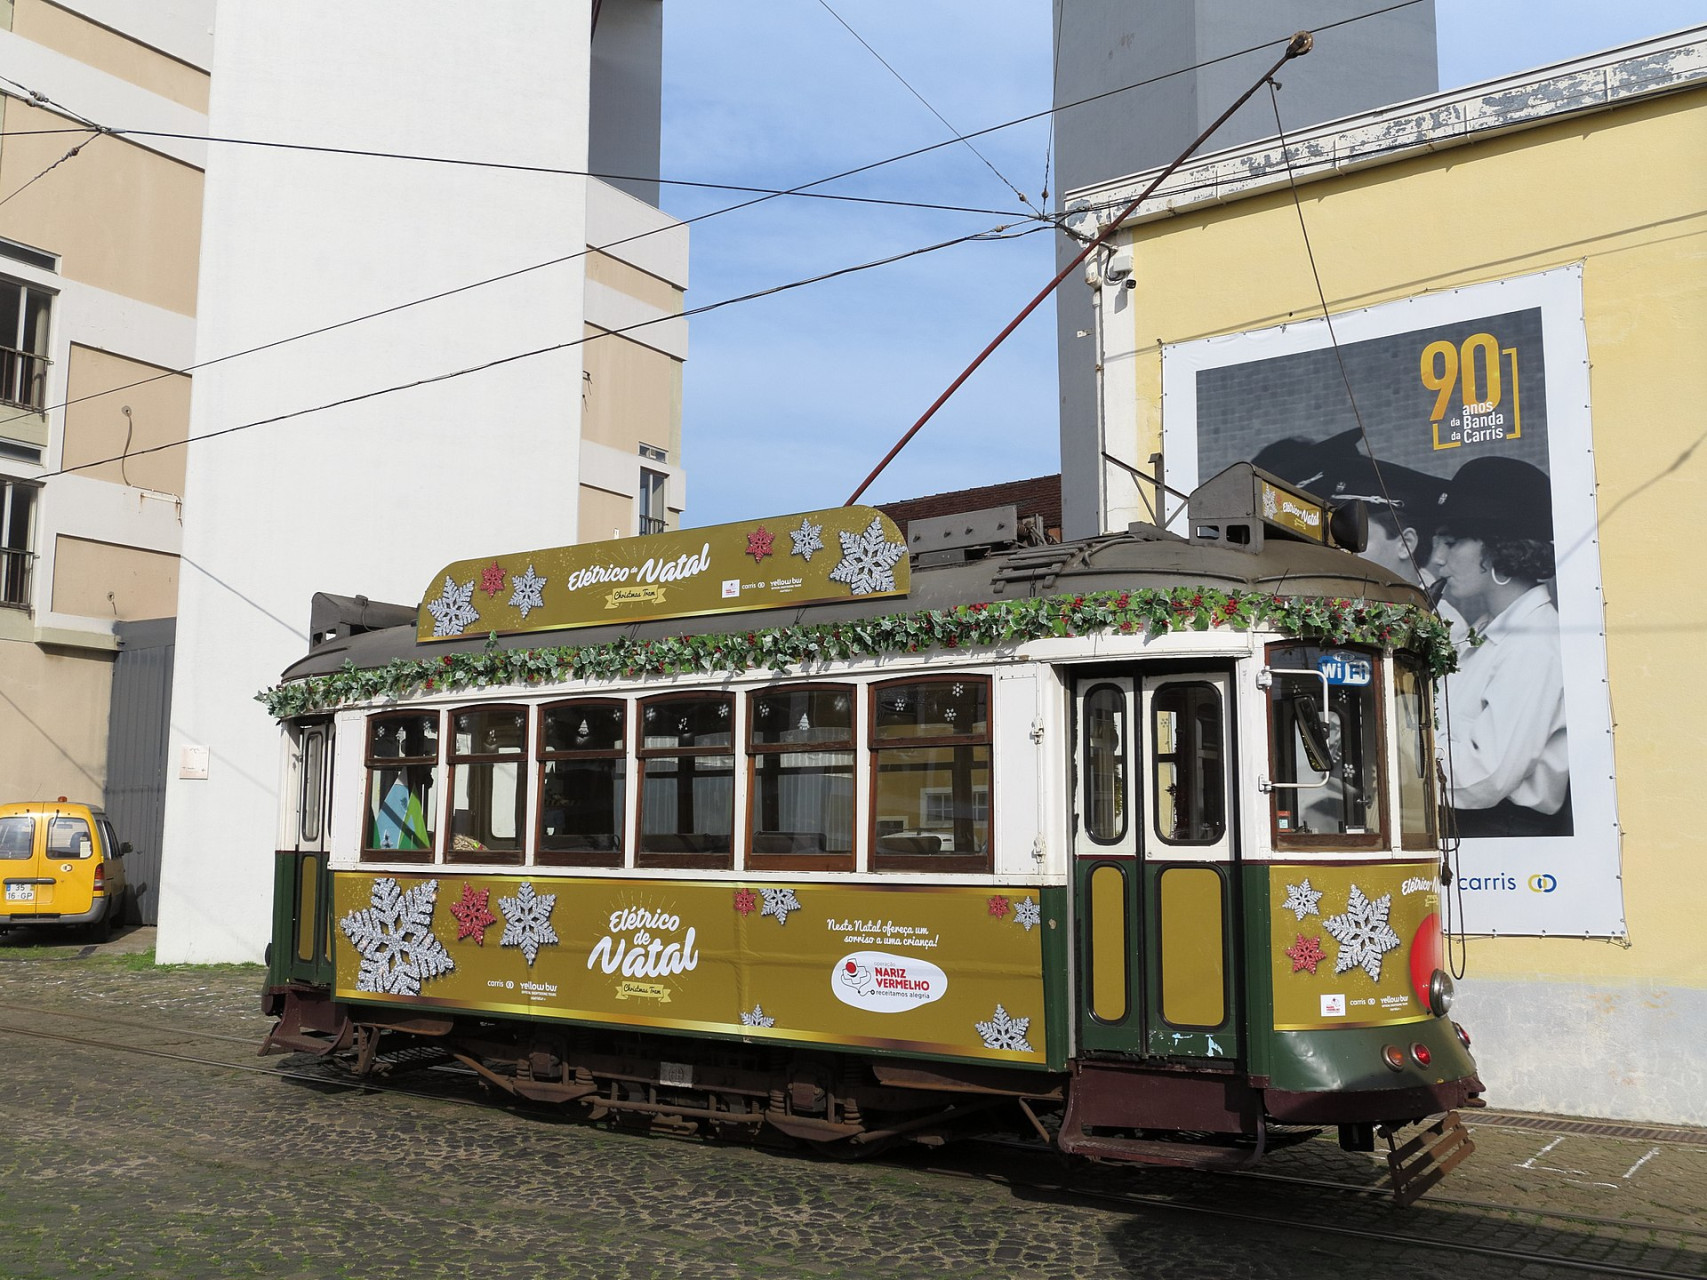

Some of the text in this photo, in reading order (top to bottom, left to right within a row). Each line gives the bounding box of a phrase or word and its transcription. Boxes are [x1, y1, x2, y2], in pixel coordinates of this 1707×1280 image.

[1420, 332, 1502, 421] 90
[1462, 401, 1494, 416] anos
[1450, 411, 1504, 430] da Banda
[1451, 426, 1504, 444] da Carris
[567, 563, 630, 592] Elétrico
[636, 542, 711, 583] Natal
[15, 883, 26, 891] 35
[1458, 872, 1517, 890] carris
[608, 905, 681, 933] Elétrico
[826, 918, 930, 937] Neste Natal ofereça um
[633, 929, 652, 946] de
[843, 934, 875, 944] sorriso
[883, 937, 902, 946] uma
[902, 934, 940, 950] criança!
[587, 927, 699, 978] Natal
[874, 967, 907, 979] NARIZ
[487, 980, 558, 992] carris yellow bus
[875, 978, 930, 991] VERMELHO
[875, 990, 931, 999] receitamos alegria
